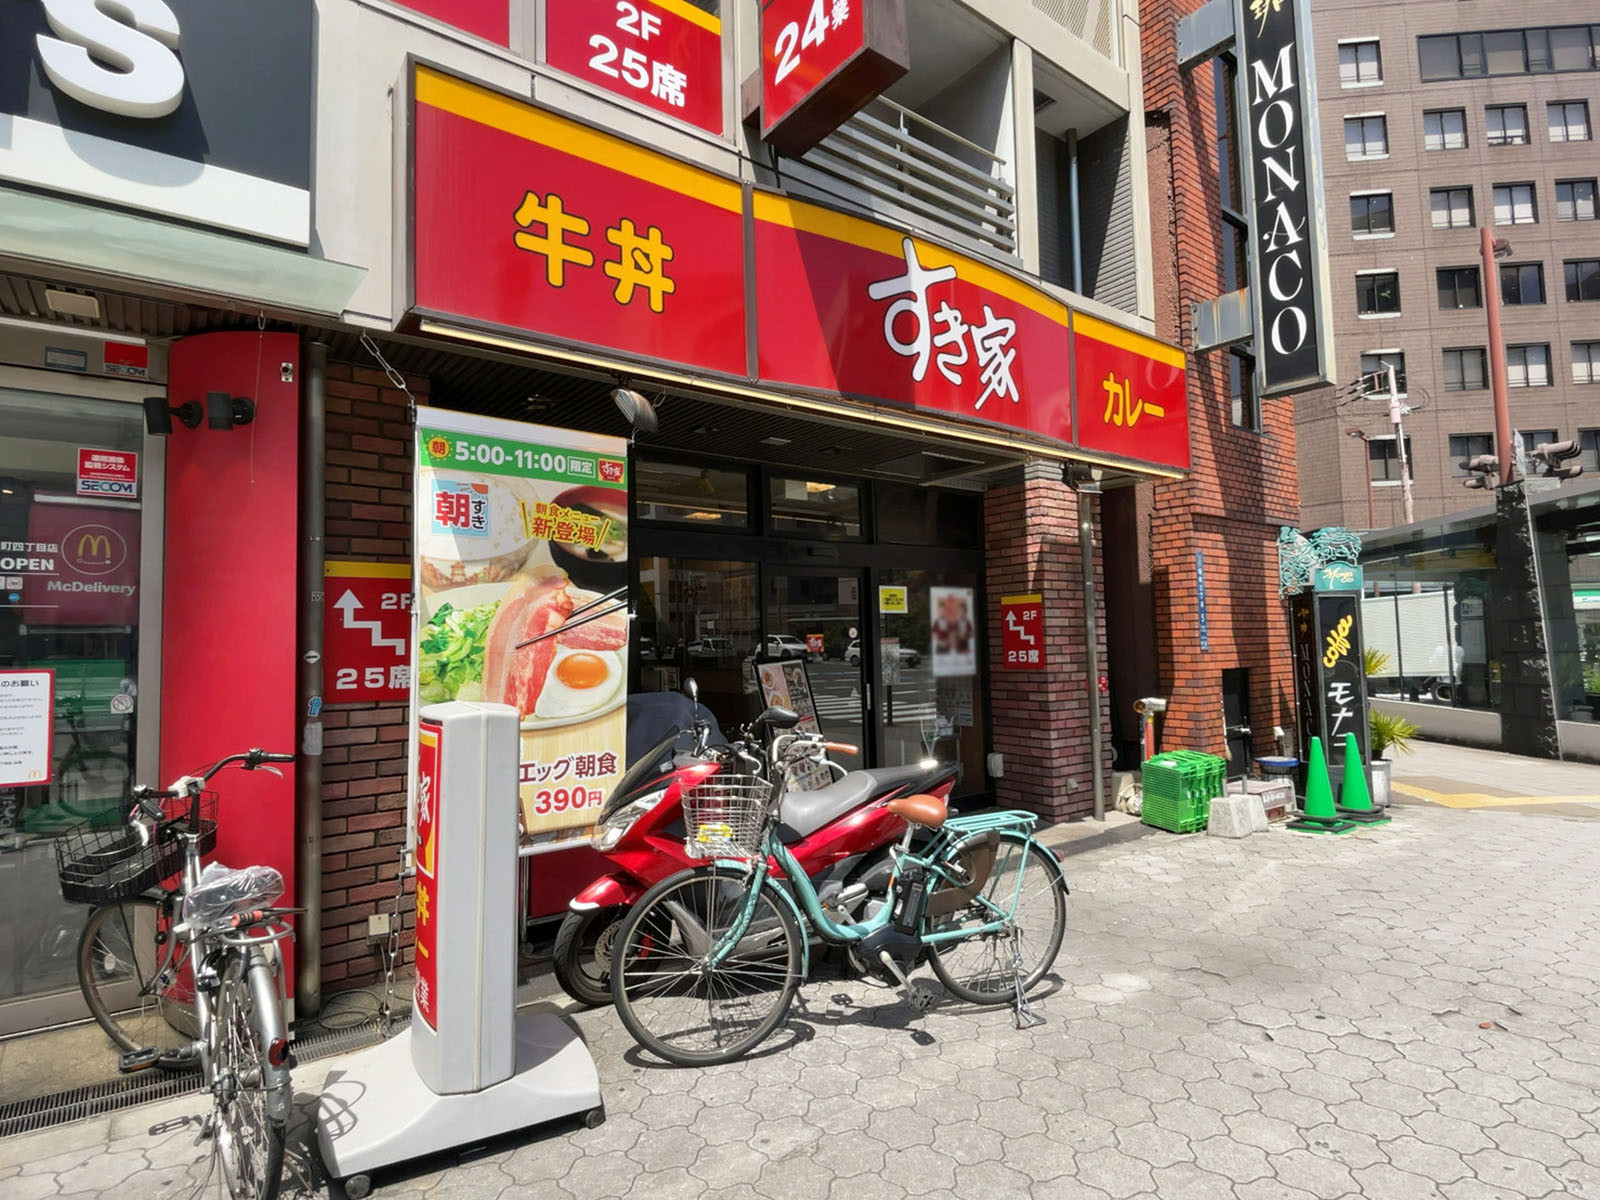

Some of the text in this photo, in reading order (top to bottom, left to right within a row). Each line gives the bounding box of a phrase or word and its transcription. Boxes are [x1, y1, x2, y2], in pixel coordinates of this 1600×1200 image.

[616, 1, 662, 40] 2F
[774, 0, 830, 86] 24
[35, 0, 185, 118] S
[588, 34, 687, 108] 25席
[1251, 42, 1307, 355] MONACO
[513, 190, 676, 313] 牛丼
[868, 237, 1019, 410] すき家
[1102, 371, 1165, 428] カレー
[432, 441, 446, 455] 朝
[455, 441, 566, 473] 5:00-11:00
[569, 459, 594, 474] 限定
[81, 480, 133, 493] SECOM
[435, 491, 488, 530] 朝 すき
[534, 502, 600, 522] 朝食メニュー
[0, 541, 58, 552] 町四丁目店
[532, 516, 596, 547] 新登場
[0, 557, 54, 570] OPEN
[47, 581, 136, 595] McDelivery
[381, 592, 411, 610] 2F
[1023, 610, 1037, 620] 2F
[1008, 650, 1039, 663] 25席
[1322, 614, 1353, 669] coffee
[0, 679, 39, 687] のお願い
[336, 665, 411, 690] 25席
[1300, 643, 1314, 749] MONAC
[519, 752, 618, 783] エッグ朝食
[535, 785, 602, 814] 390円
